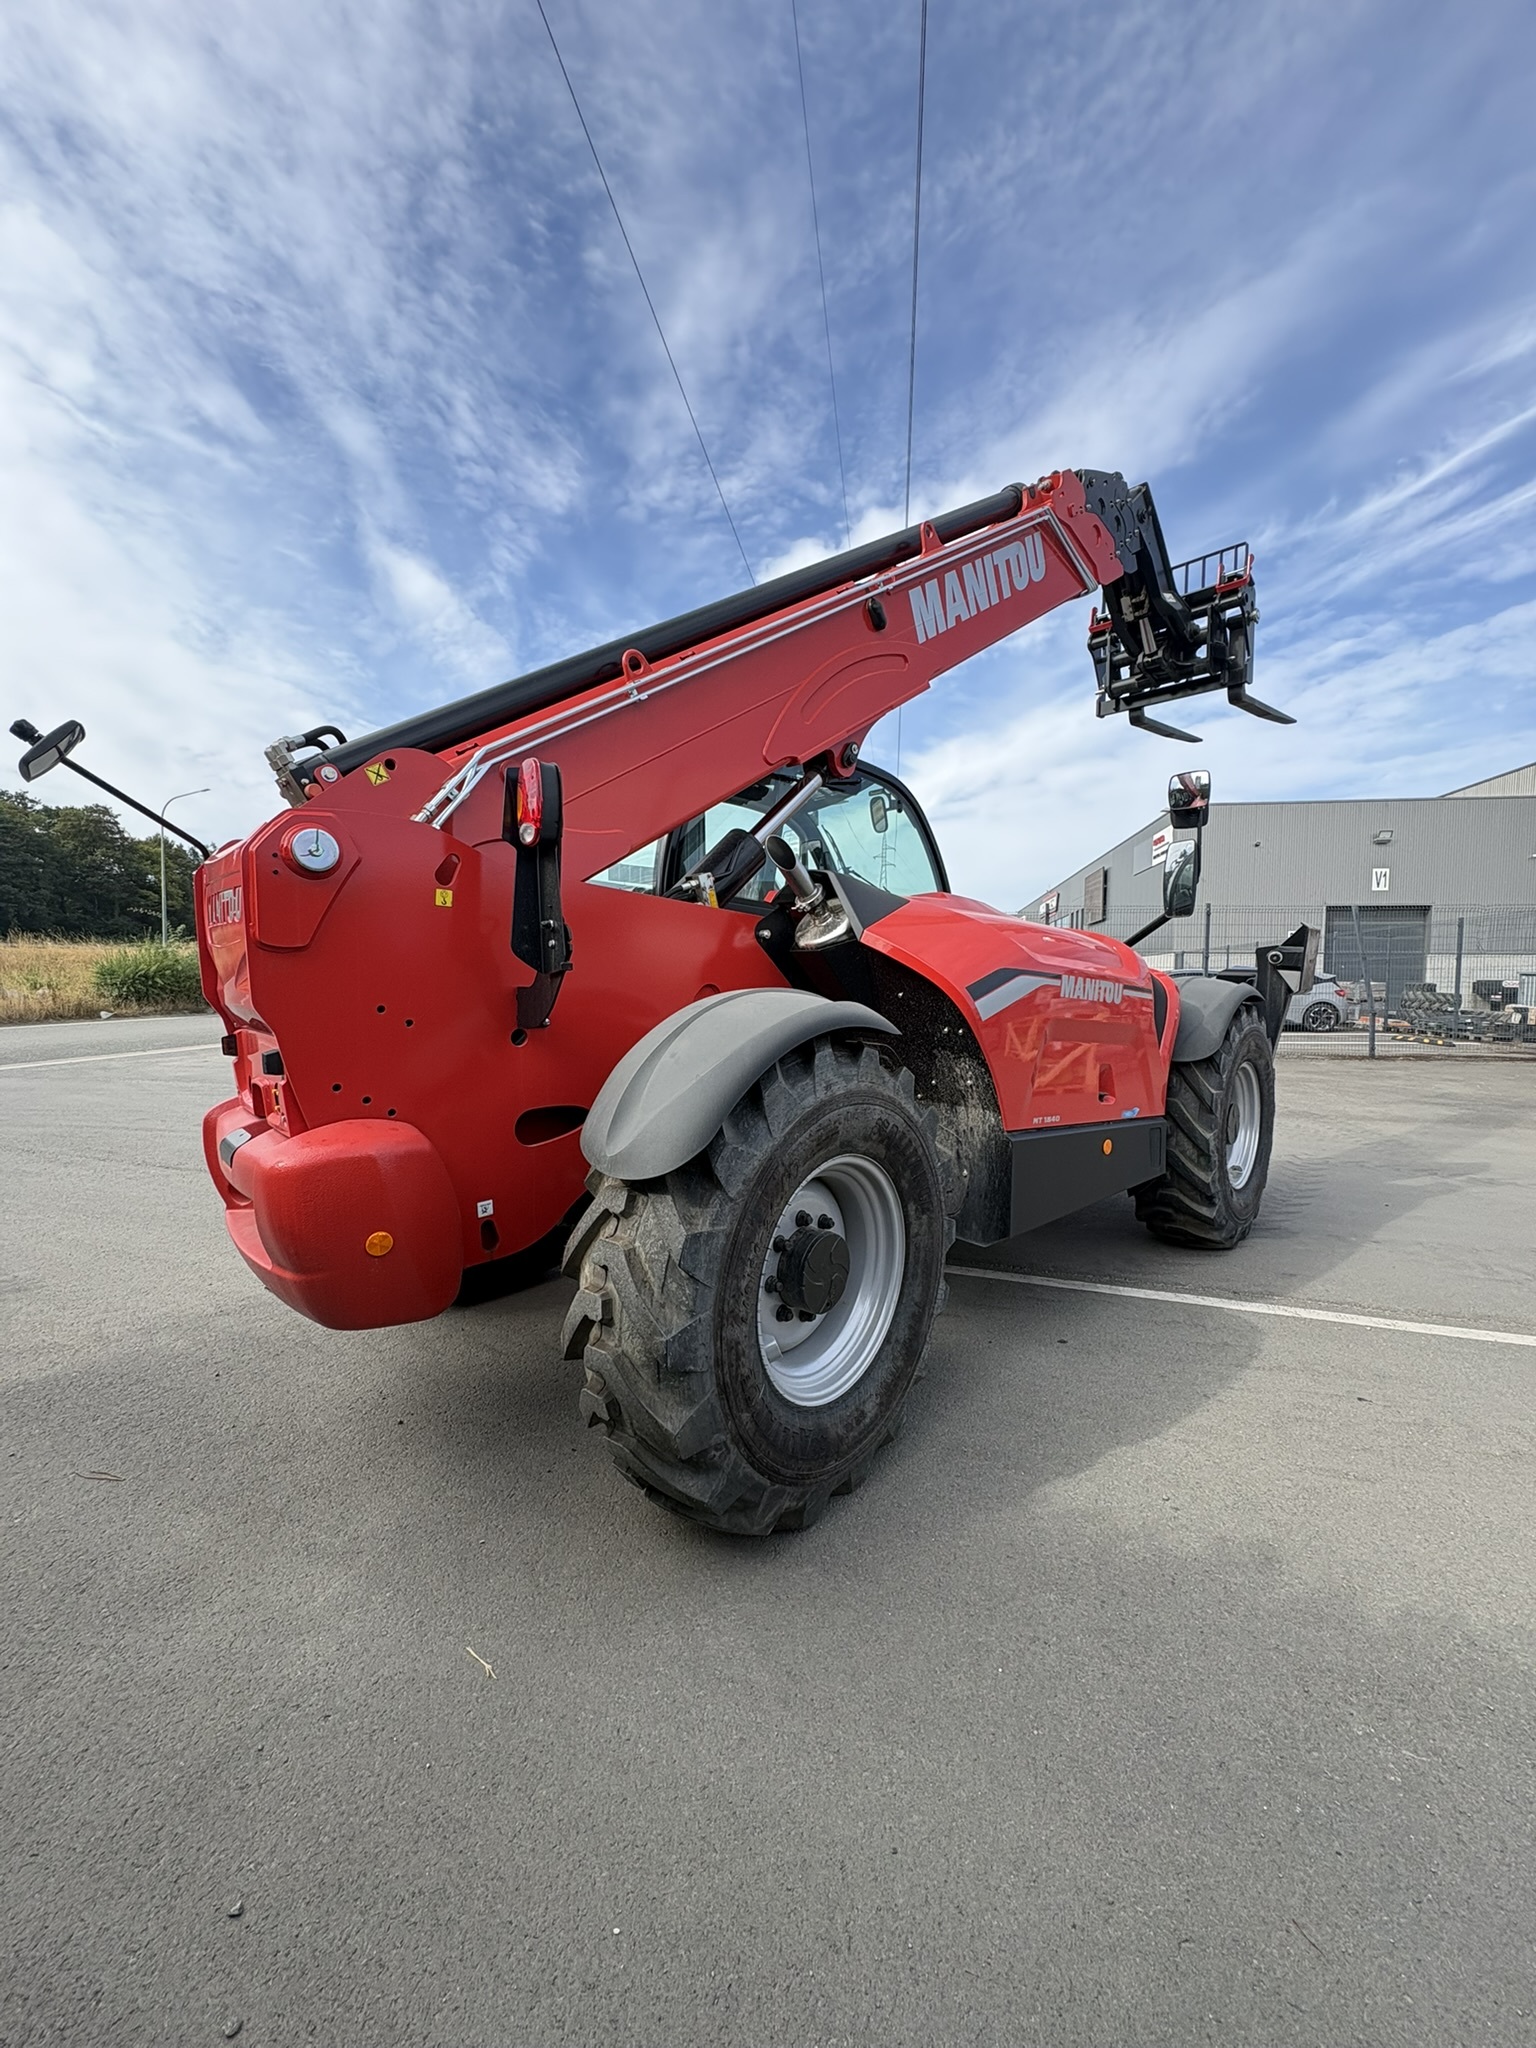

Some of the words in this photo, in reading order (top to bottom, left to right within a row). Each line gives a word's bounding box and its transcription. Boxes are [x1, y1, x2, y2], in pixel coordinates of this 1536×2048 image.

[908, 531, 1046, 645] MANITOU
[1375, 870, 1387, 889] V1
[1060, 974, 1123, 1005] MANITOU
